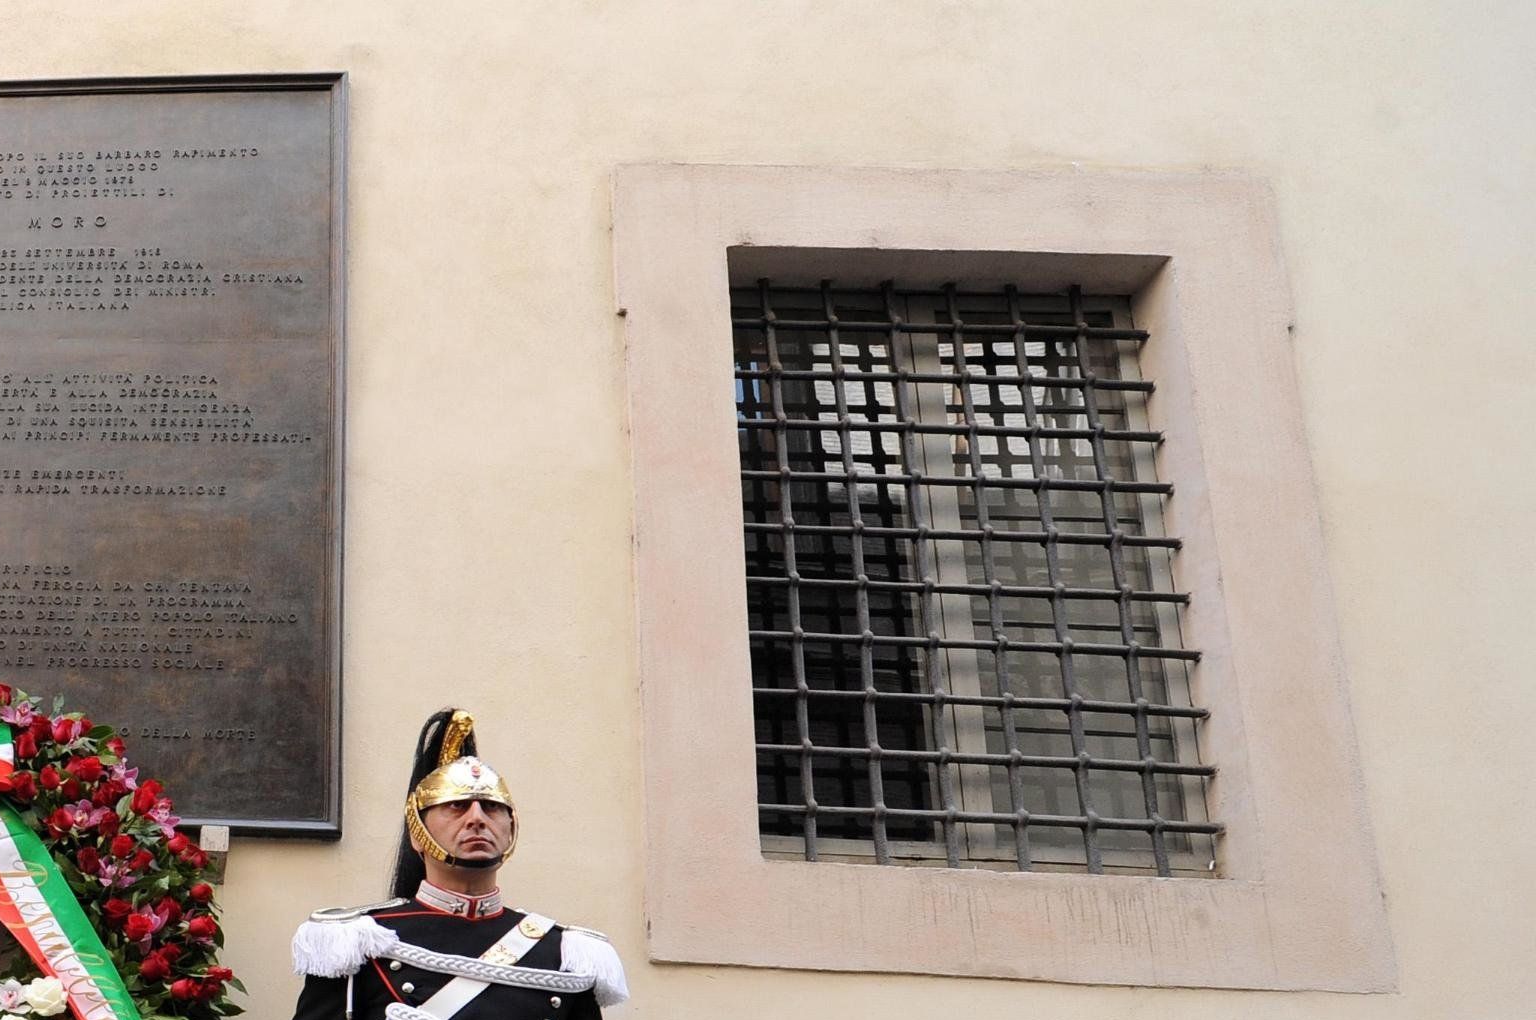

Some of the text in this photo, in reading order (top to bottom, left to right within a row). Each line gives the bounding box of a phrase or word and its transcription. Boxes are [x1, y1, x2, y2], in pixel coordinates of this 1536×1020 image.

[34, 152, 47, 161] IL
[58, 152, 84, 160] SUO
[96, 150, 161, 160] BARBARO
[173, 148, 258, 158] RAPIMENTO
[37, 164, 95, 174] QUESTO
[105, 163, 159, 172] LUOGO
[38, 176, 97, 186] MAGGIO
[26, 189, 40, 199] DI
[51, 188, 145, 198] PROIETTILI
[158, 188, 173, 197] DI
[28, 216, 107, 229] MORO
[26, 248, 116, 257] SETTEMBRE
[138, 261, 152, 270] DI
[162, 261, 204, 270] ROMA
[55, 274, 104, 284] DELLA
[114, 274, 212, 284] DEMOCRAZIA
[222, 273, 303, 284] CRISTIANA
[18, 287, 101, 297] CONSIGLIO
[113, 287, 139, 297] DEI
[149, 287, 216, 297] MINISTRI
[48, 301, 130, 311] ITALIANA
[144, 374, 218, 384] POLITICA
[68, 388, 108, 398] ALLA
[120, 388, 218, 398] DEMOCRAZIA
[35, 403, 60, 412] SUA
[71, 403, 123, 413] LUCIDA
[133, 403, 251, 414] INTELLIGENZA
[7, 416, 21, 426] DI
[31, 416, 58, 426] UNA
[68, 417, 138, 428] SQUISITA
[2, 431, 16, 441] AI
[25, 431, 90, 442] PRINCIPI
[100, 431, 200, 442] FERMAMENTE
[32, 470, 125, 480] EMERGENTI
[14, 485, 71, 495] RAPIDA
[81, 485, 227, 496] TRASFORMAZIONE
[32, 580, 102, 592] FEROCIA
[113, 581, 134, 592] DA
[144, 582, 169, 593] CHI
[179, 582, 252, 593] TENTAVA
[93, 596, 107, 607] DI
[119, 597, 136, 607] UN
[147, 597, 246, 608] PROGRAMMA
[151, 611, 215, 623] POPOLO
[225, 612, 298, 624] ITALIANO
[102, 627, 145, 638] TUTTI
[168, 626, 253, 639] CITTADINI
[17, 640, 32, 651] DI
[99, 641, 193, 654] NAZIONALE
[4, 656, 35, 667] NEL
[47, 657, 142, 669] PROGRESSO
[152, 658, 225, 670] SOCIALE
[141, 727, 191, 740] DELLA
[202, 728, 257, 741] MORTE
